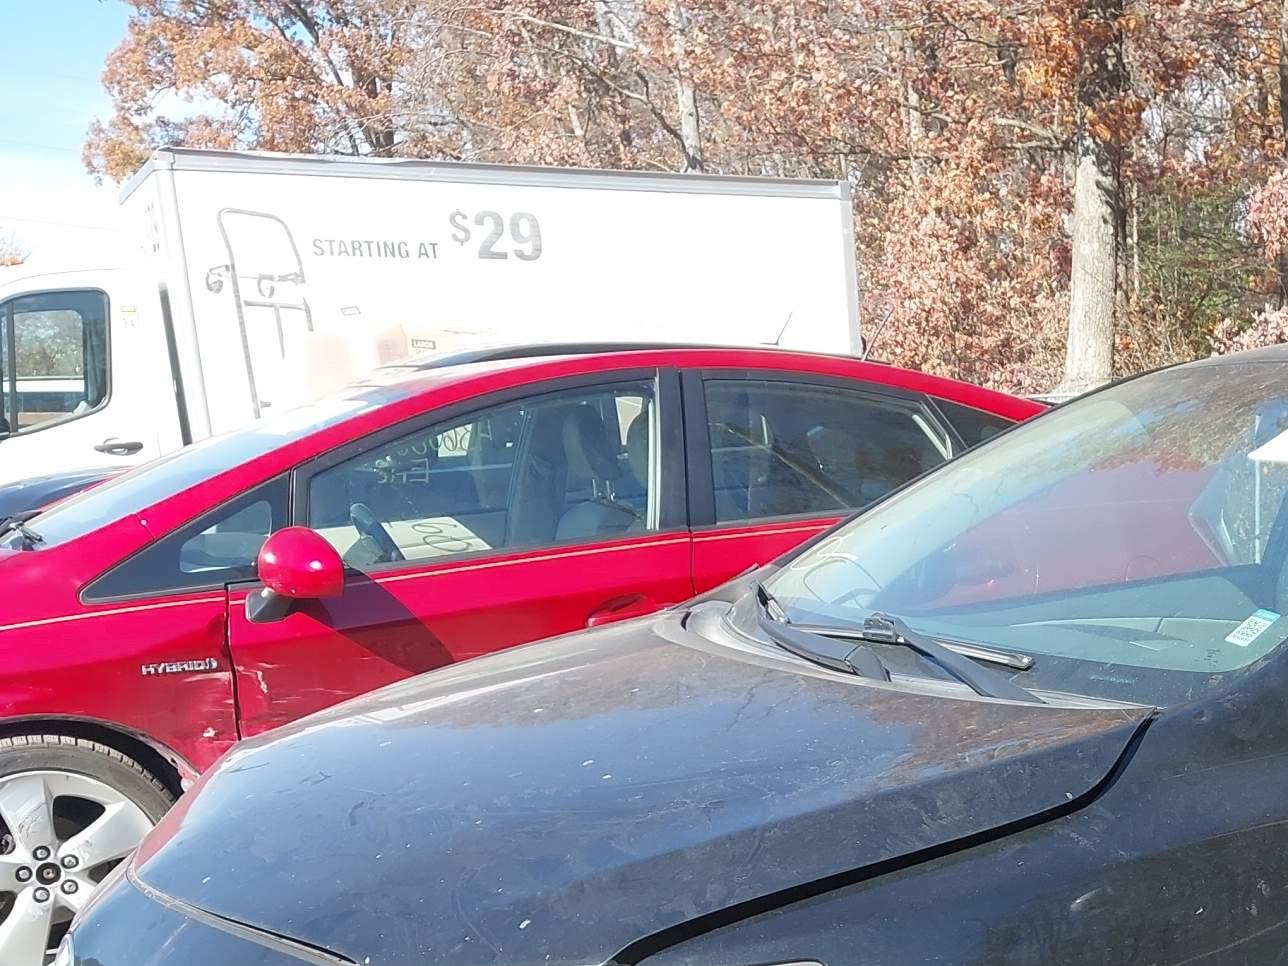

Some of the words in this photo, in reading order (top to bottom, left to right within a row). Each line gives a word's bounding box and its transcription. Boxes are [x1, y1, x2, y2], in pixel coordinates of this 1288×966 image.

[312, 238, 410, 259] STARTING
[418, 242, 439, 259] AT
[449, 208, 543, 261] $29
[141, 660, 205, 676] HYBRID
